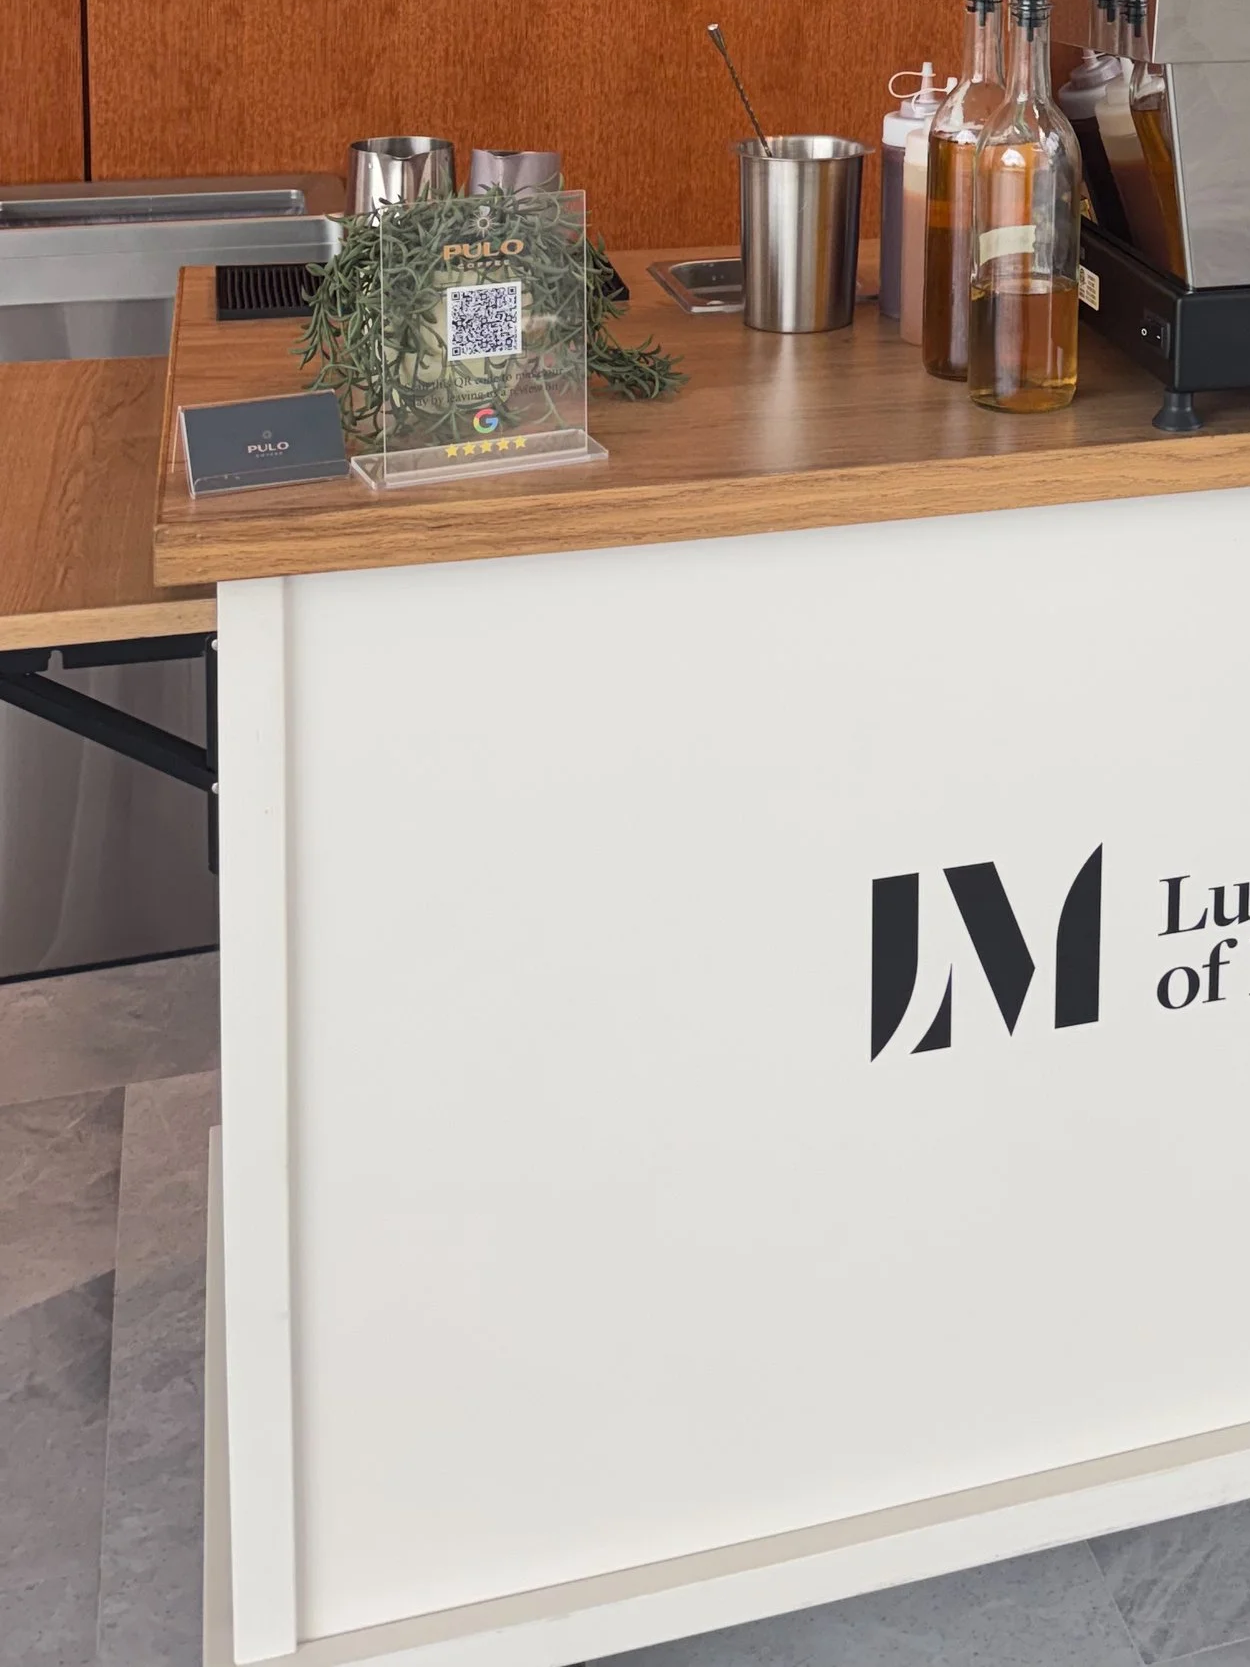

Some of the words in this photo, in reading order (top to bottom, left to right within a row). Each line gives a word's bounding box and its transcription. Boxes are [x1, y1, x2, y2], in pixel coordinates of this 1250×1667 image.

[443, 238, 524, 261] PULO
[454, 376, 473, 388] QR
[247, 441, 290, 454] PULO
[1156, 938, 1239, 1010] of
